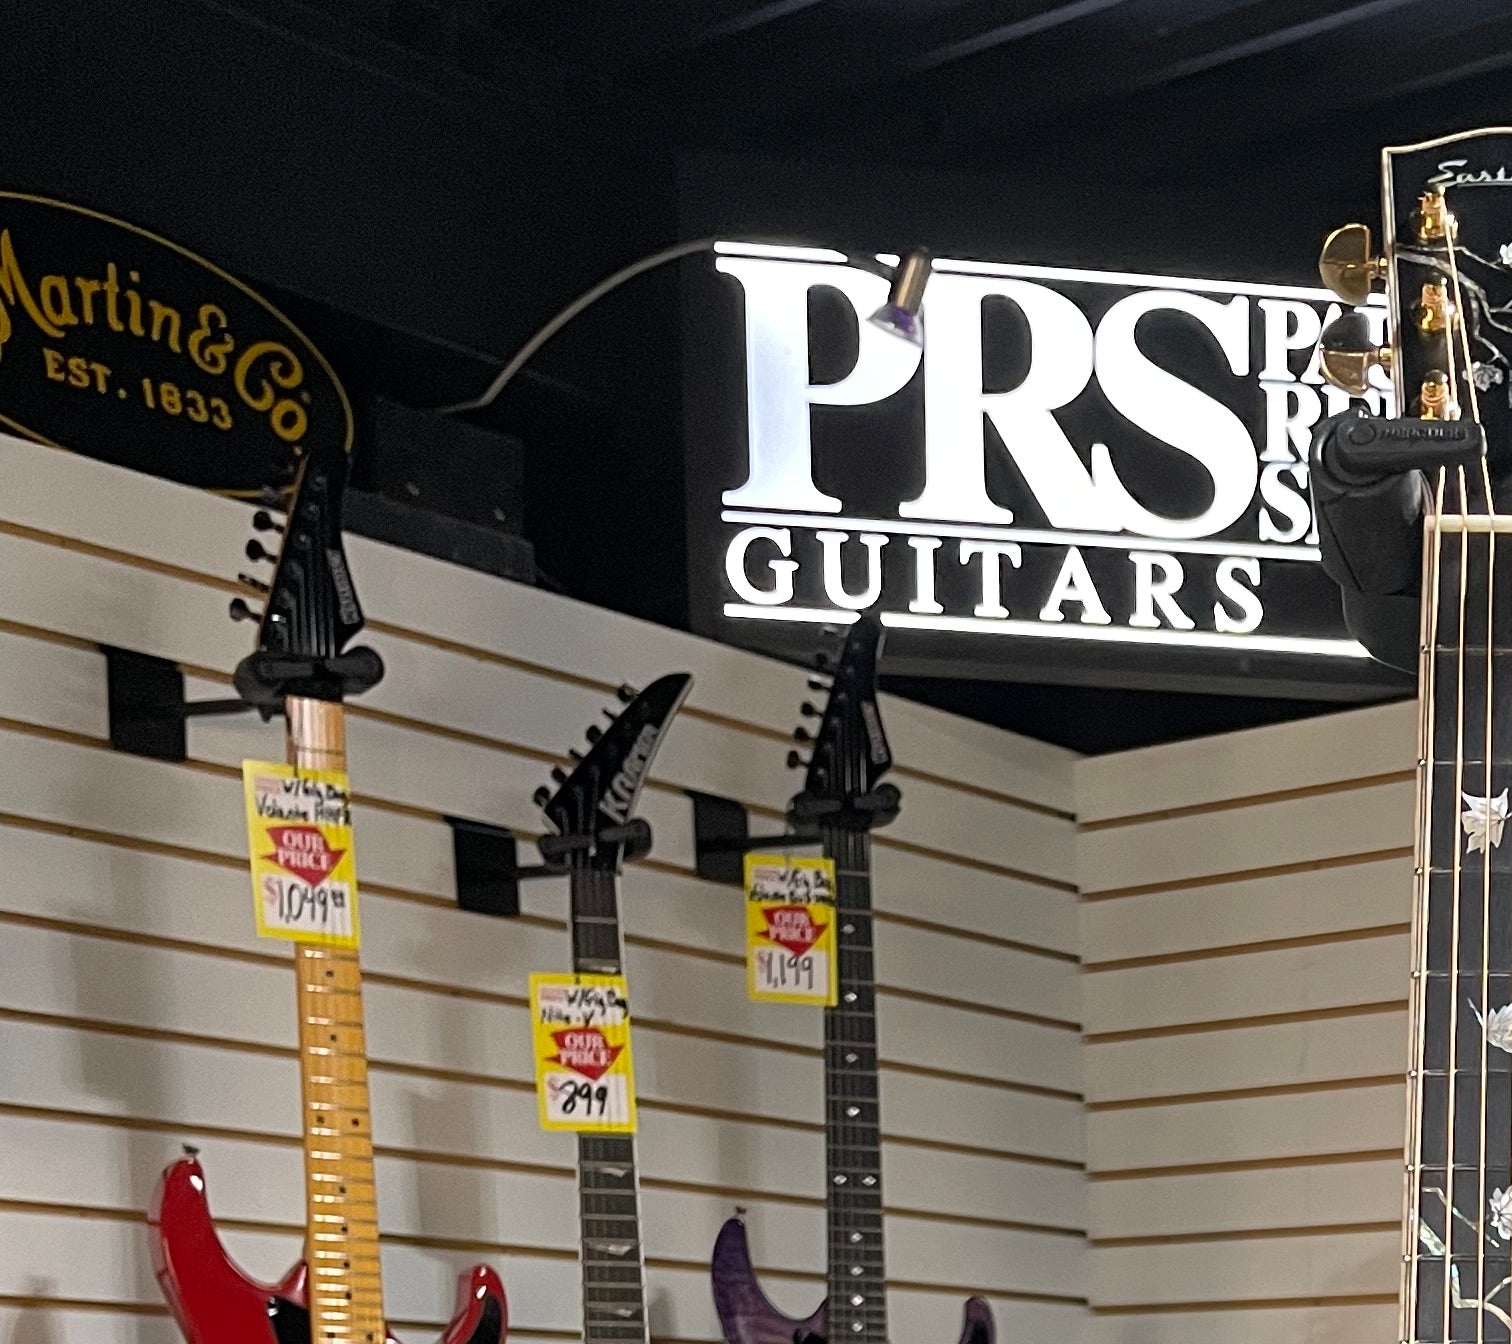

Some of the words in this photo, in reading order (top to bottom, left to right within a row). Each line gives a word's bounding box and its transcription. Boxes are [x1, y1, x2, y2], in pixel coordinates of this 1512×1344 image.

[142, 378, 232, 431] 1833
[715, 257, 1258, 541] PRS
[725, 526, 1264, 635] GUITARS
[283, 831, 324, 851] OUR
[277, 850, 331, 872] PRICE
[565, 1032, 605, 1050] OUR
[560, 1048, 611, 1068] PRICE
